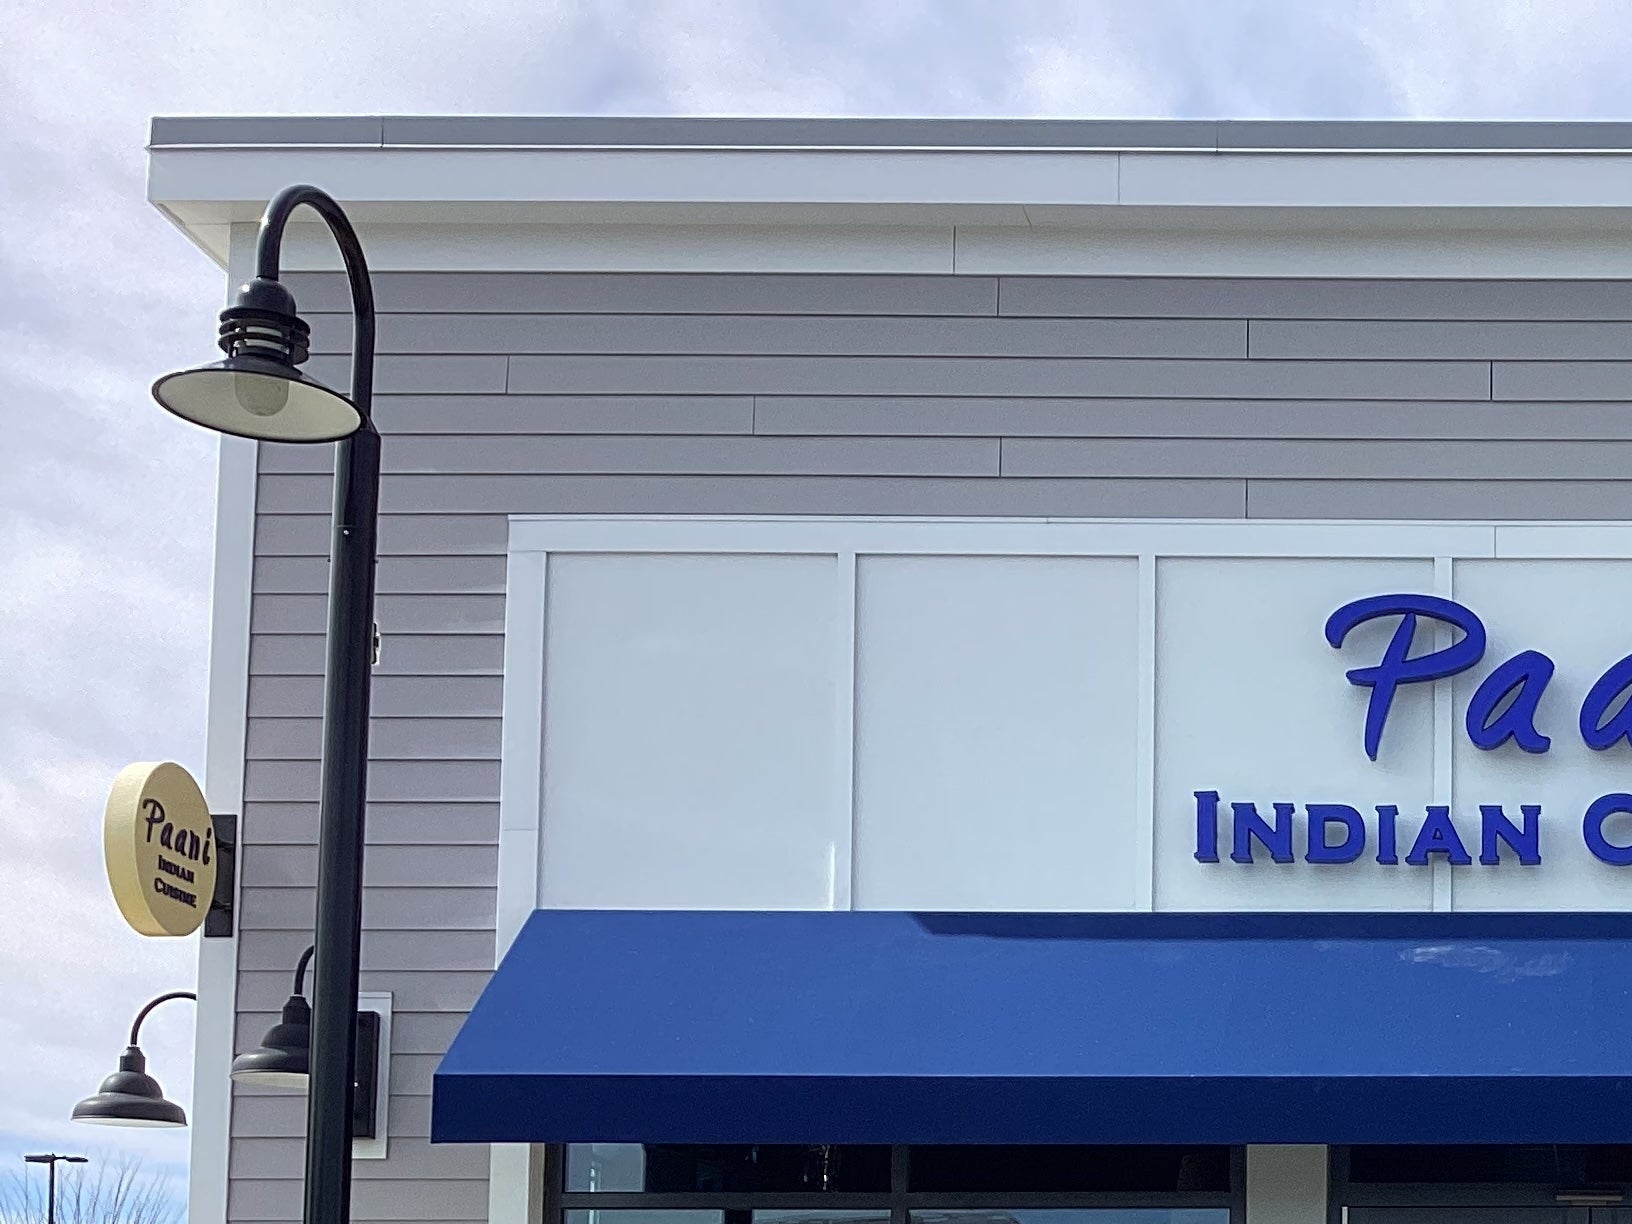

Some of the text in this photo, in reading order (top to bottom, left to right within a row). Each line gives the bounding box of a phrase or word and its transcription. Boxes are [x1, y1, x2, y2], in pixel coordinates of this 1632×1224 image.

[142, 798, 212, 866] Paani
[1192, 789, 1542, 865] INDIAN
[154, 877, 197, 908] CUISINE
[158, 854, 195, 884] INDIAN
